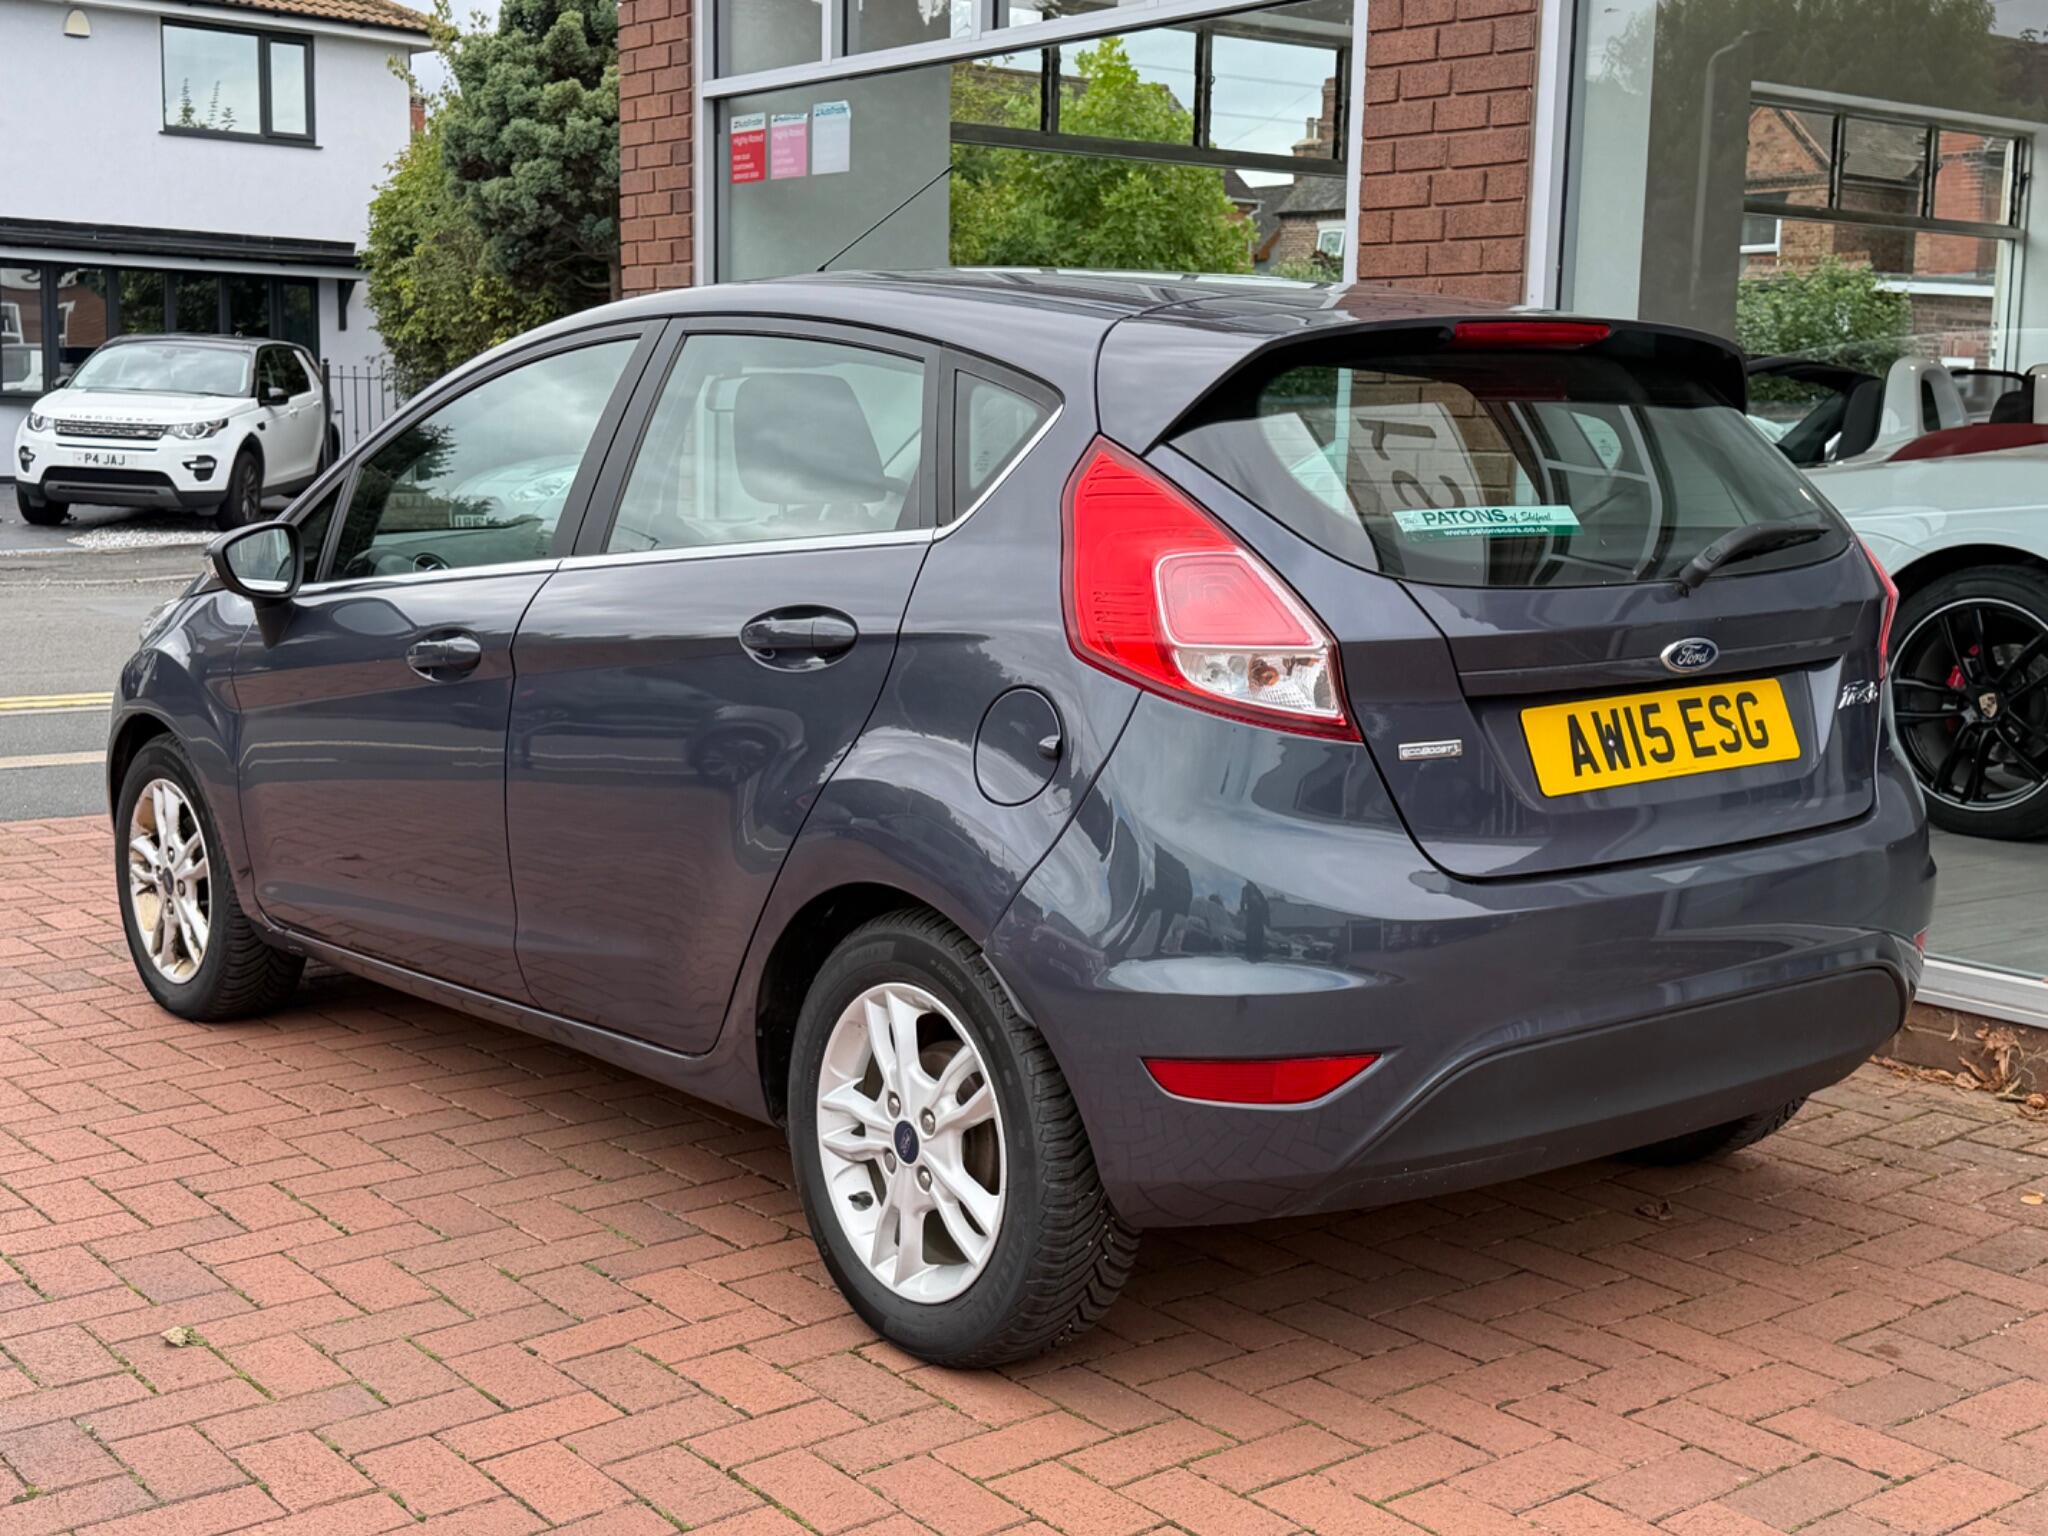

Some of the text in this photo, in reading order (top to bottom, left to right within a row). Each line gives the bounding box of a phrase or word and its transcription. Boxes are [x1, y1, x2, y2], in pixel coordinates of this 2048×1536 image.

[84, 452, 126, 467] P4 JAJ
[1421, 508, 1508, 526] PATONS
[1677, 644, 1710, 665] Ford
[1567, 691, 1770, 777] AW15 ESG
